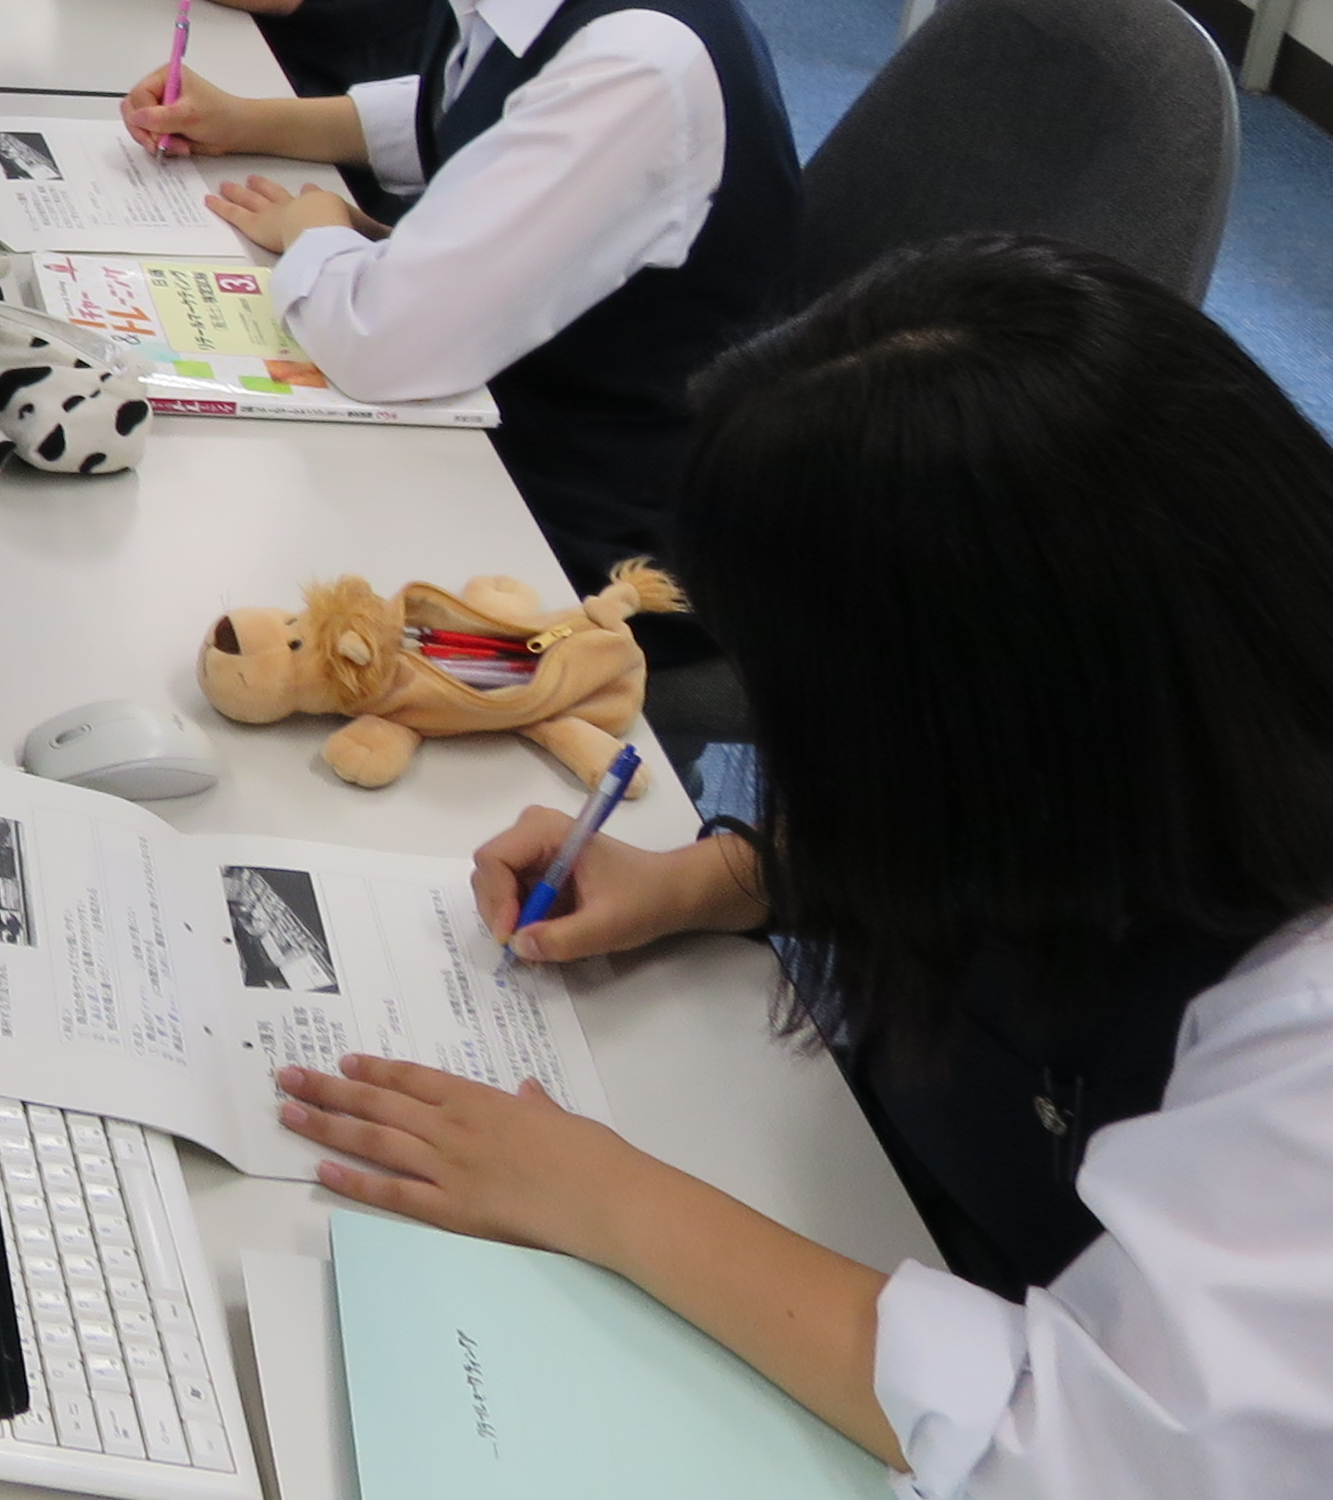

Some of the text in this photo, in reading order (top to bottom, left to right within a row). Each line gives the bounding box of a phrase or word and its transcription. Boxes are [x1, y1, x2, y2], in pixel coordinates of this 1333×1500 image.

[167, 268, 216, 351] リテールマーケティング
